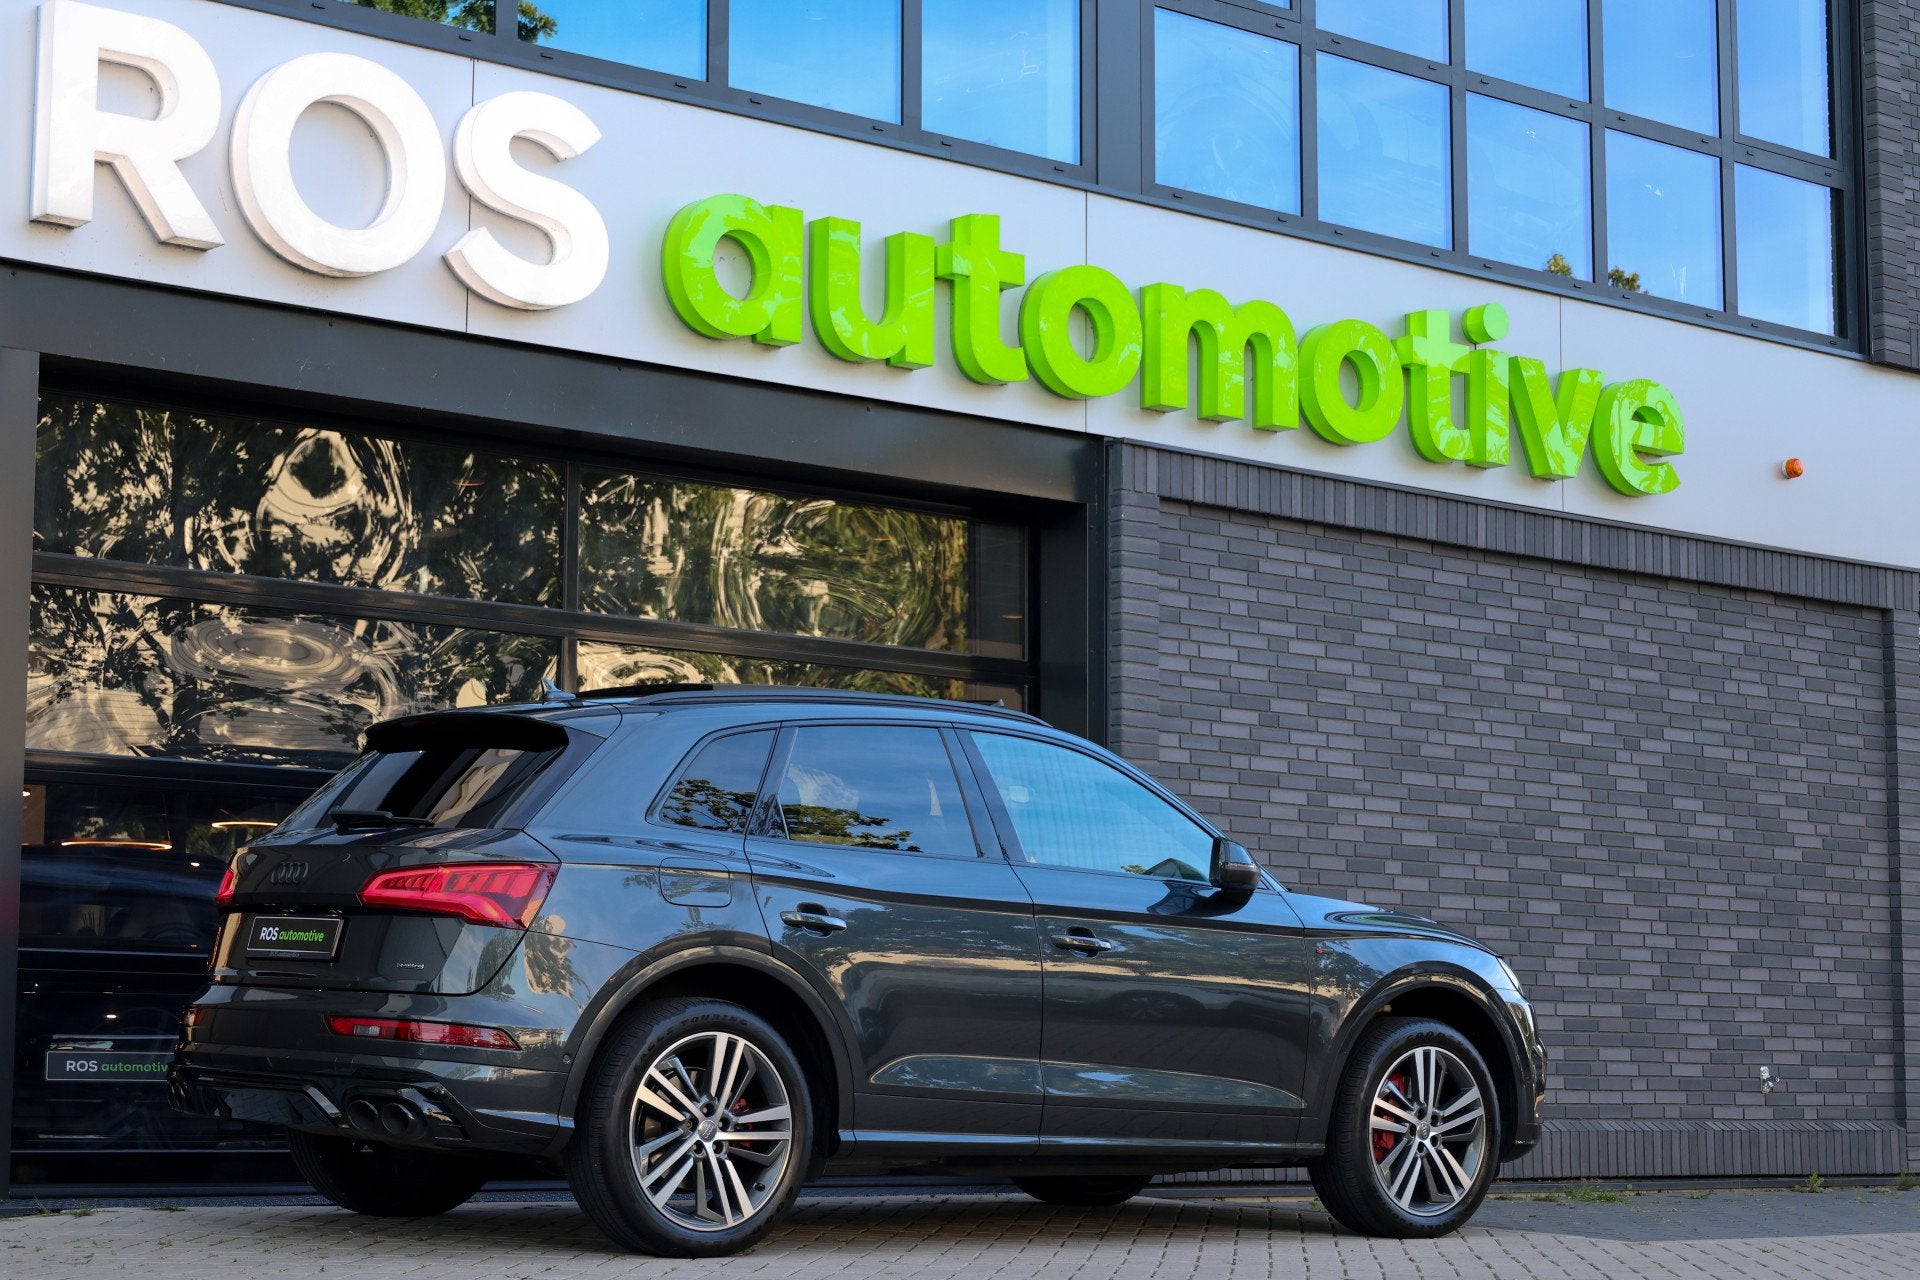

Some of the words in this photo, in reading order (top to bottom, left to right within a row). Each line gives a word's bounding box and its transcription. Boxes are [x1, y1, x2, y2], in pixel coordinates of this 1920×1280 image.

[29, 0, 609, 311] ROS
[661, 193, 1686, 498] automotive
[259, 927, 279, 941] ROS
[279, 929, 325, 942] automotive
[66, 1060, 98, 1072] ROS
[101, 1061, 168, 1072] automotiv
